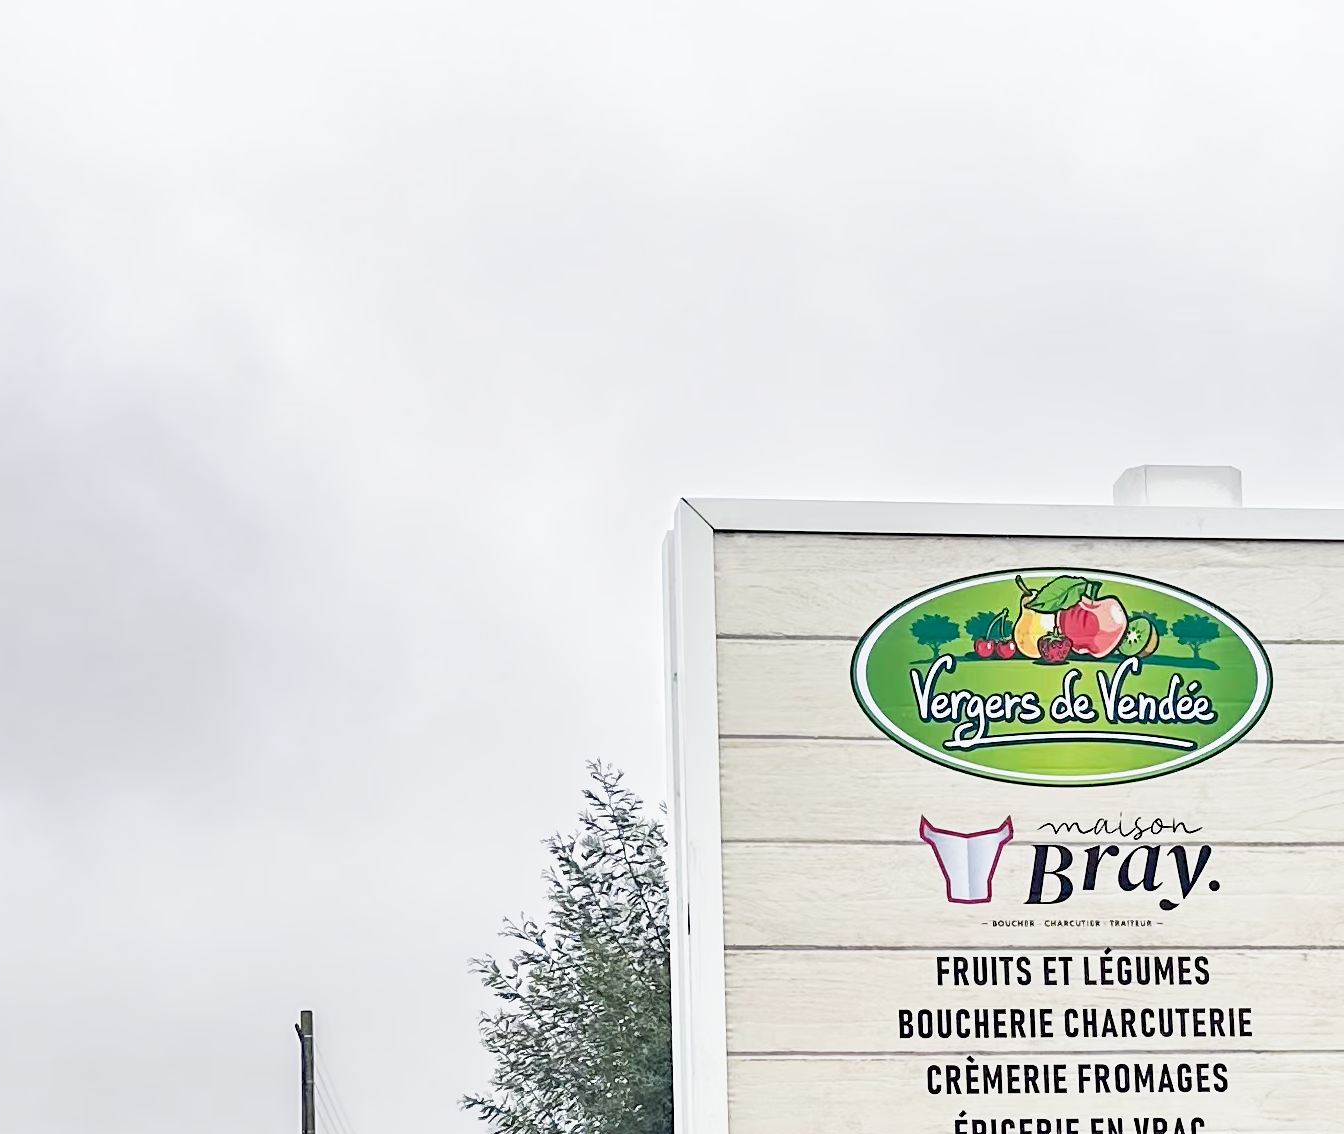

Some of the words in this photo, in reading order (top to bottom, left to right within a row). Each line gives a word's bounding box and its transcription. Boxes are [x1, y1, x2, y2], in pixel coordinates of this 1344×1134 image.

[910, 655, 1042, 746] Vergers
[1051, 669, 1096, 723] de
[1097, 655, 1219, 724] Vendée
[1037, 811, 1203, 841] maison
[1023, 844, 1221, 911] Bray.
[992, 919, 1035, 927] BOUCHER
[1044, 919, 1101, 927] CHARCUTIER
[1109, 919, 1153, 927] TRAITEUR
[936, 956, 1032, 986] FRUITS
[1043, 956, 1073, 986] ET
[1083, 947, 1210, 986] LÉGUMES
[898, 1009, 1054, 1039] BOUCHERIE
[1064, 1007, 1253, 1038] CHARCUTERIE
[927, 1056, 1067, 1095] CRÈMERIE
[1078, 1063, 1229, 1093] FROMAGES
